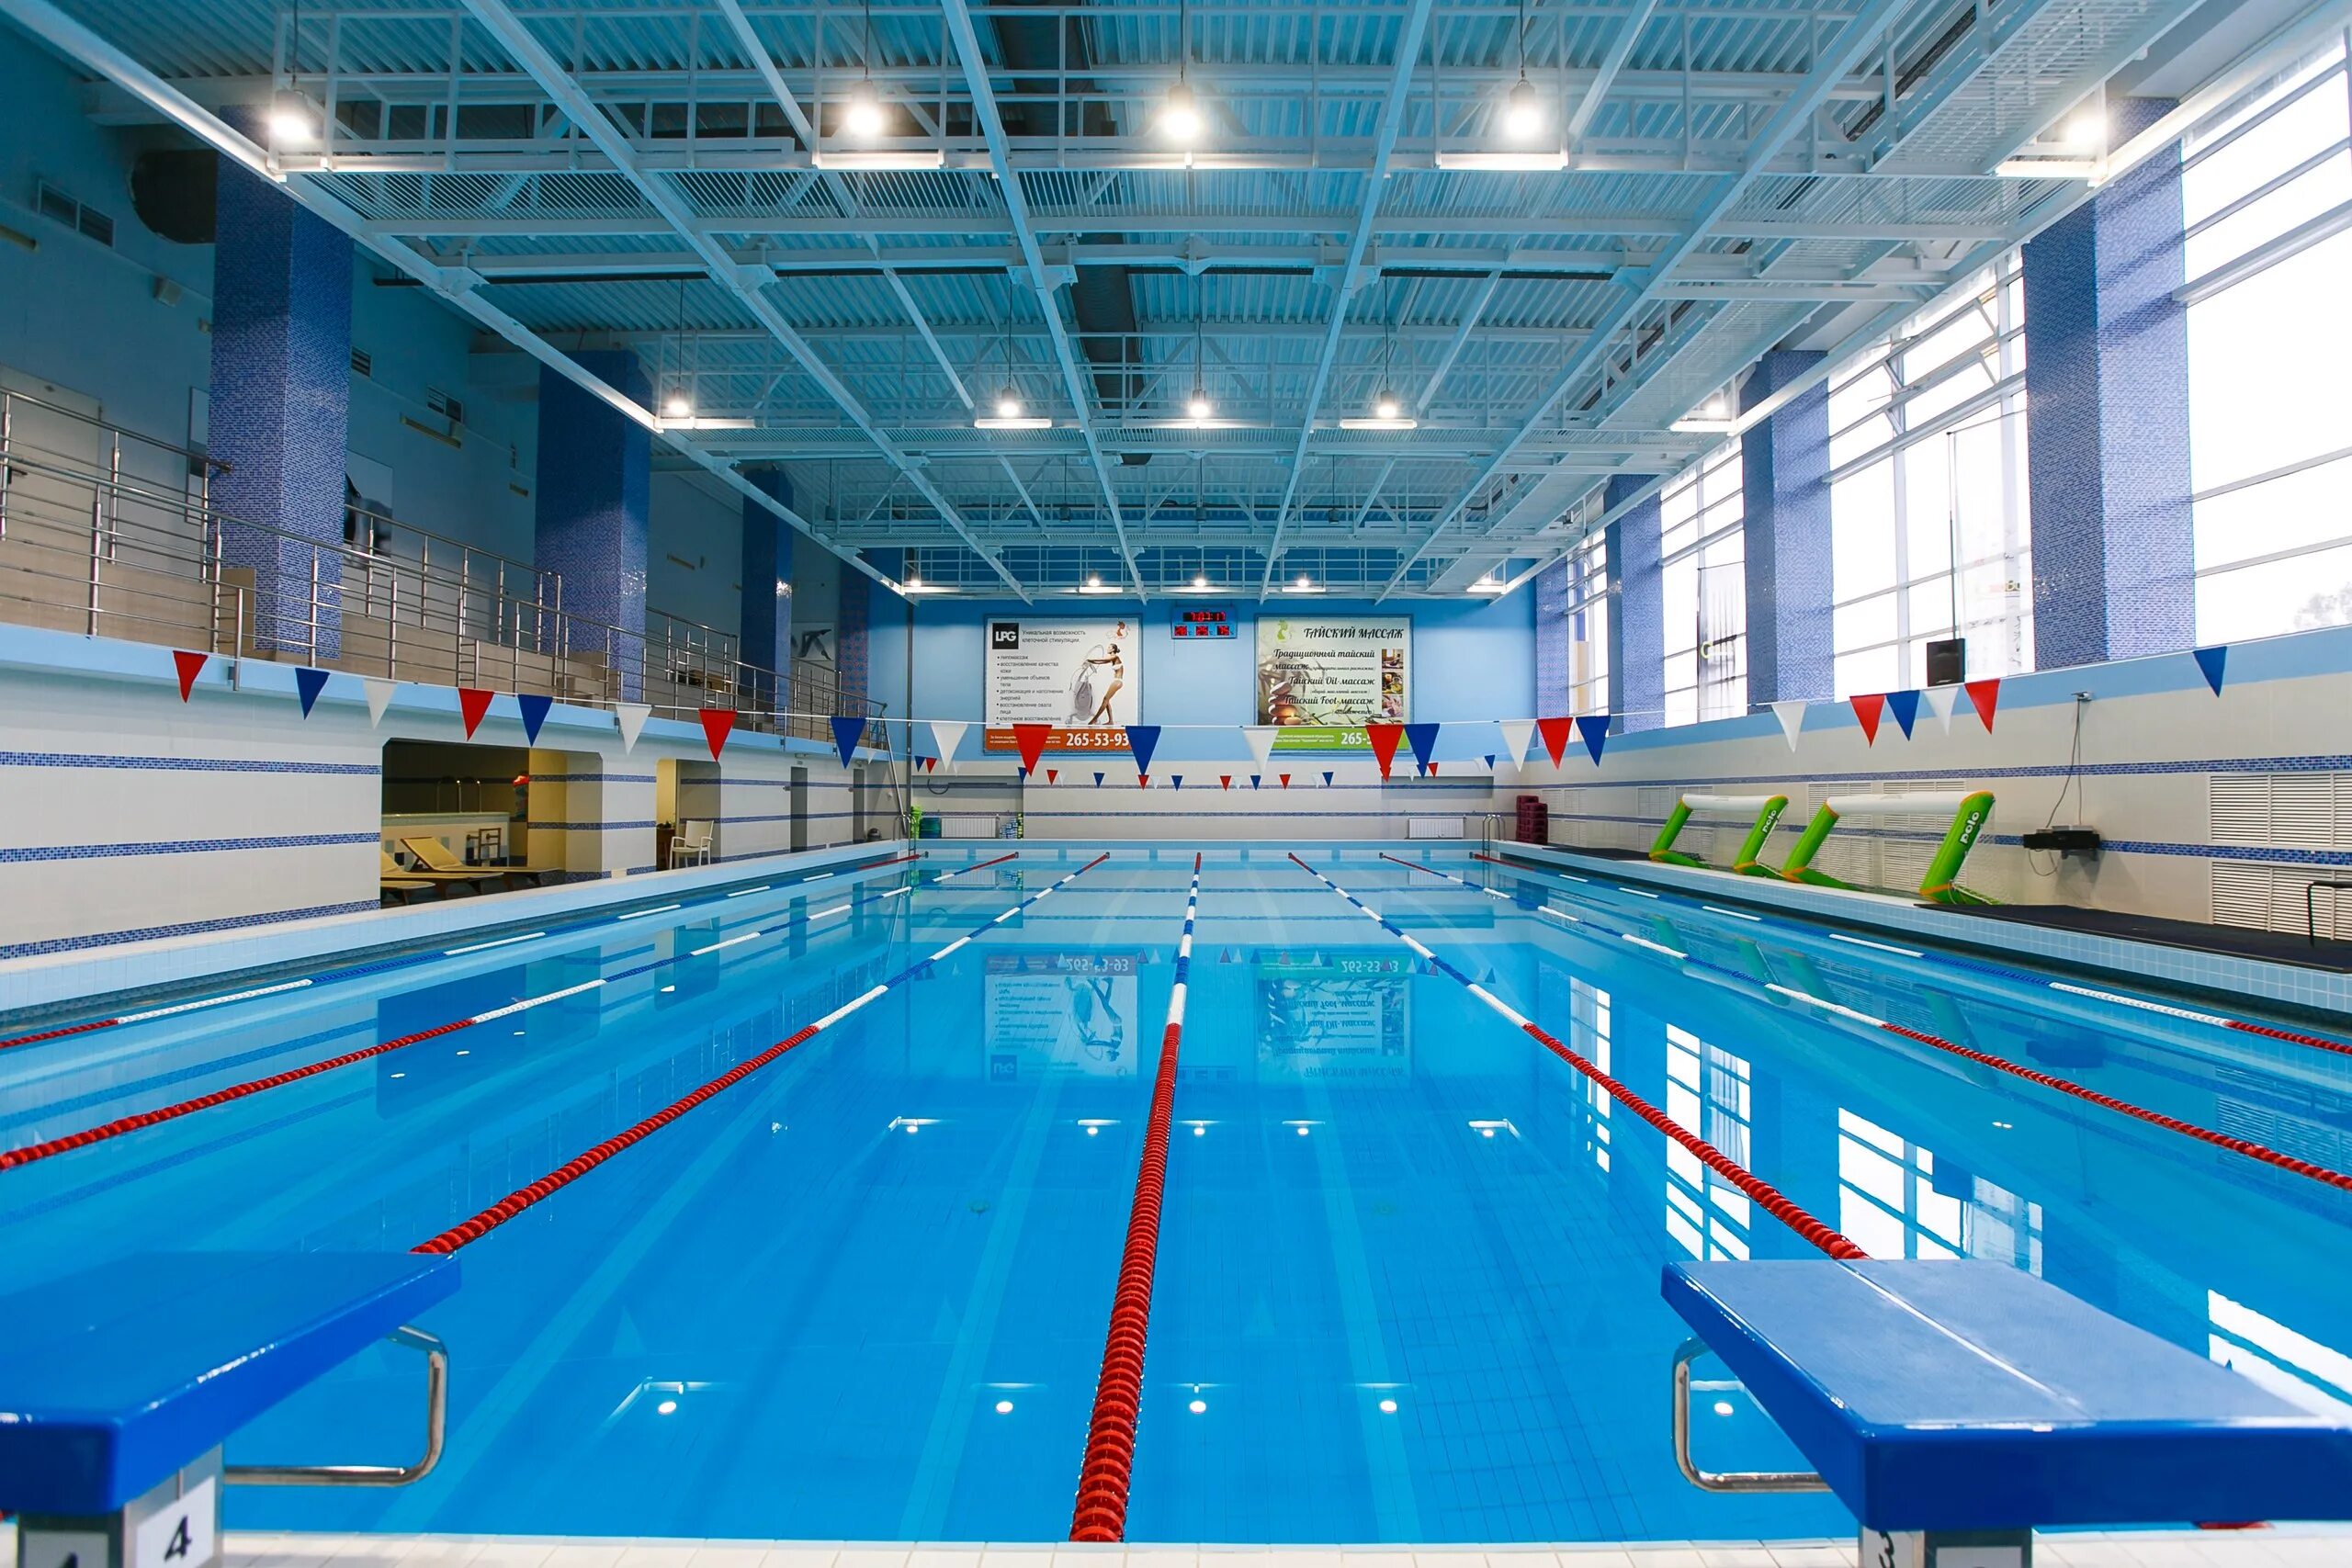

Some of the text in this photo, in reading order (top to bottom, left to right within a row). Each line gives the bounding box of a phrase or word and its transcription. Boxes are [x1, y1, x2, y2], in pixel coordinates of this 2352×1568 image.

[995, 630, 1017, 642] LPG
[1303, 626, 1404, 639] ТАЙСКИЙ МАССАЖ
[1273, 649, 1375, 660] Традиционный тайский
[1273, 662, 1309, 671] массаж
[1288, 676, 1323, 686] Тайский
[1284, 695, 1374, 705] Тайский Foot-массаж
[1066, 732, 1130, 747] 265-53-93
[1761, 808, 1778, 834] polo
[1959, 811, 1981, 844] polo
[164, 1514, 192, 1562] 4
